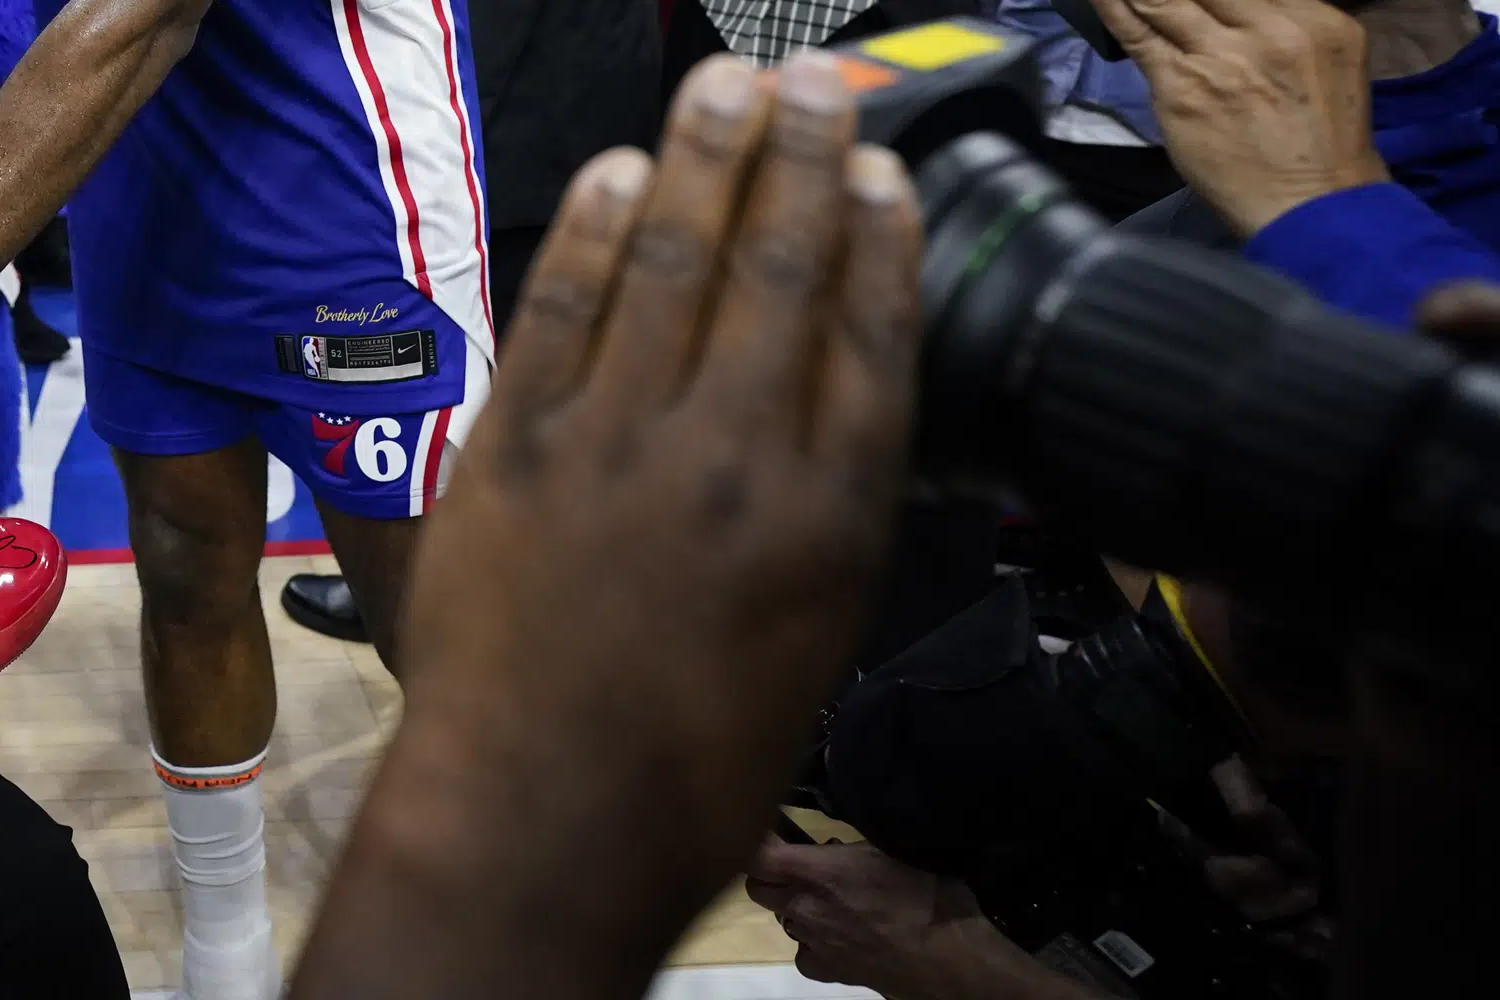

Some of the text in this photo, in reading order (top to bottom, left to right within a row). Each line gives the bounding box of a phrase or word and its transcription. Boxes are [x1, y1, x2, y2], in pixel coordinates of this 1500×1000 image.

[315, 302, 399, 327] Brotherly Love
[331, 349, 342, 358] 52
[310, 411, 408, 483] 76
